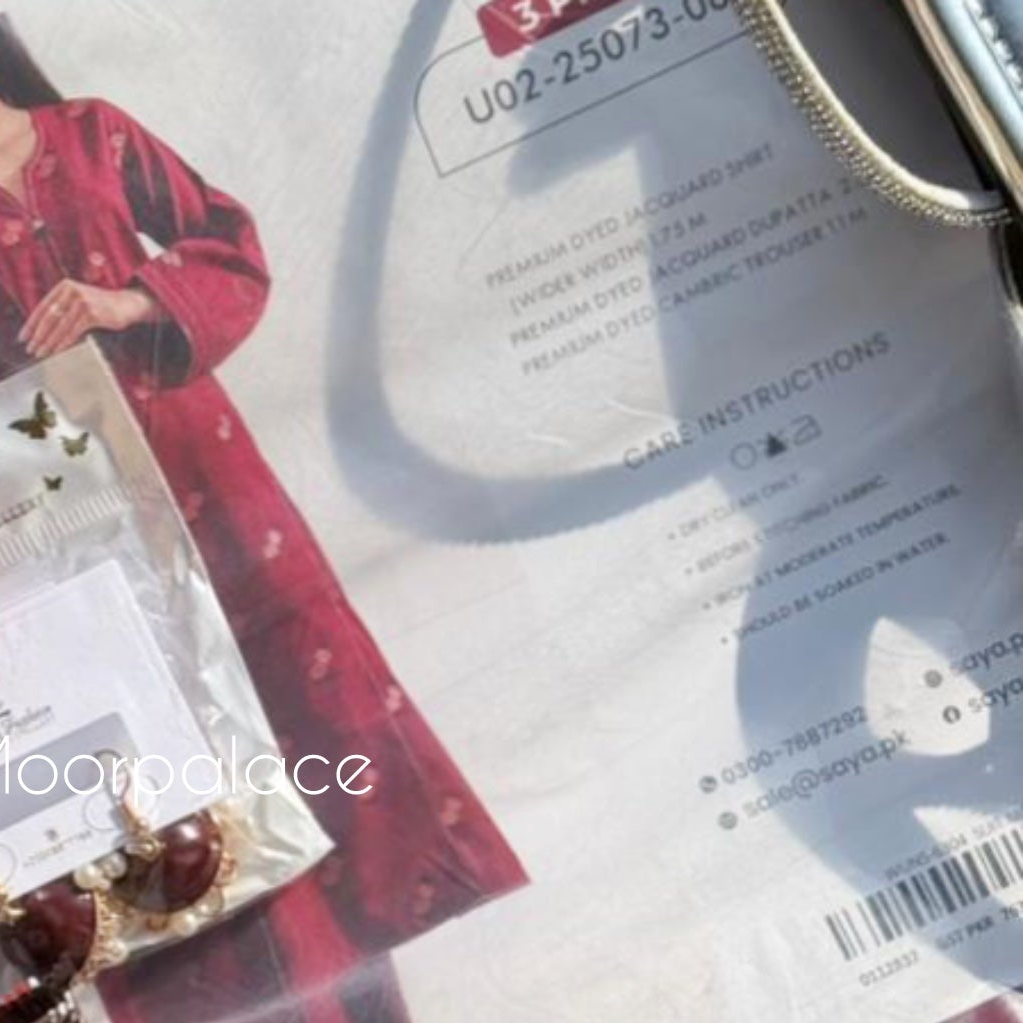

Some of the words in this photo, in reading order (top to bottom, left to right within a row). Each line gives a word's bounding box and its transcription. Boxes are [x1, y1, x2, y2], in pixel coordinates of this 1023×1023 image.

[512, 1, 541, 32] 3
[485, 241, 568, 289] PREMIUM
[569, 216, 621, 250] DYED
[622, 168, 725, 225] JACQUARD
[725, 145, 774, 177] SHIRT
[509, 300, 591, 347] PREMIUM
[593, 275, 644, 308] DYED
[747, 187, 833, 237] DUPATTA
[521, 329, 603, 377] PREMIUM
[605, 304, 657, 338] DYED
[658, 264, 743, 313] CAMBRIC
[744, 226, 824, 273] TROUSER
[623, 424, 696, 471] CARE
[700, 331, 891, 437] INSTRUCTIONS
[774, 531, 854, 578] MODERATE
[793, 594, 812, 612] BE
[814, 565, 876, 602] SOAKED
